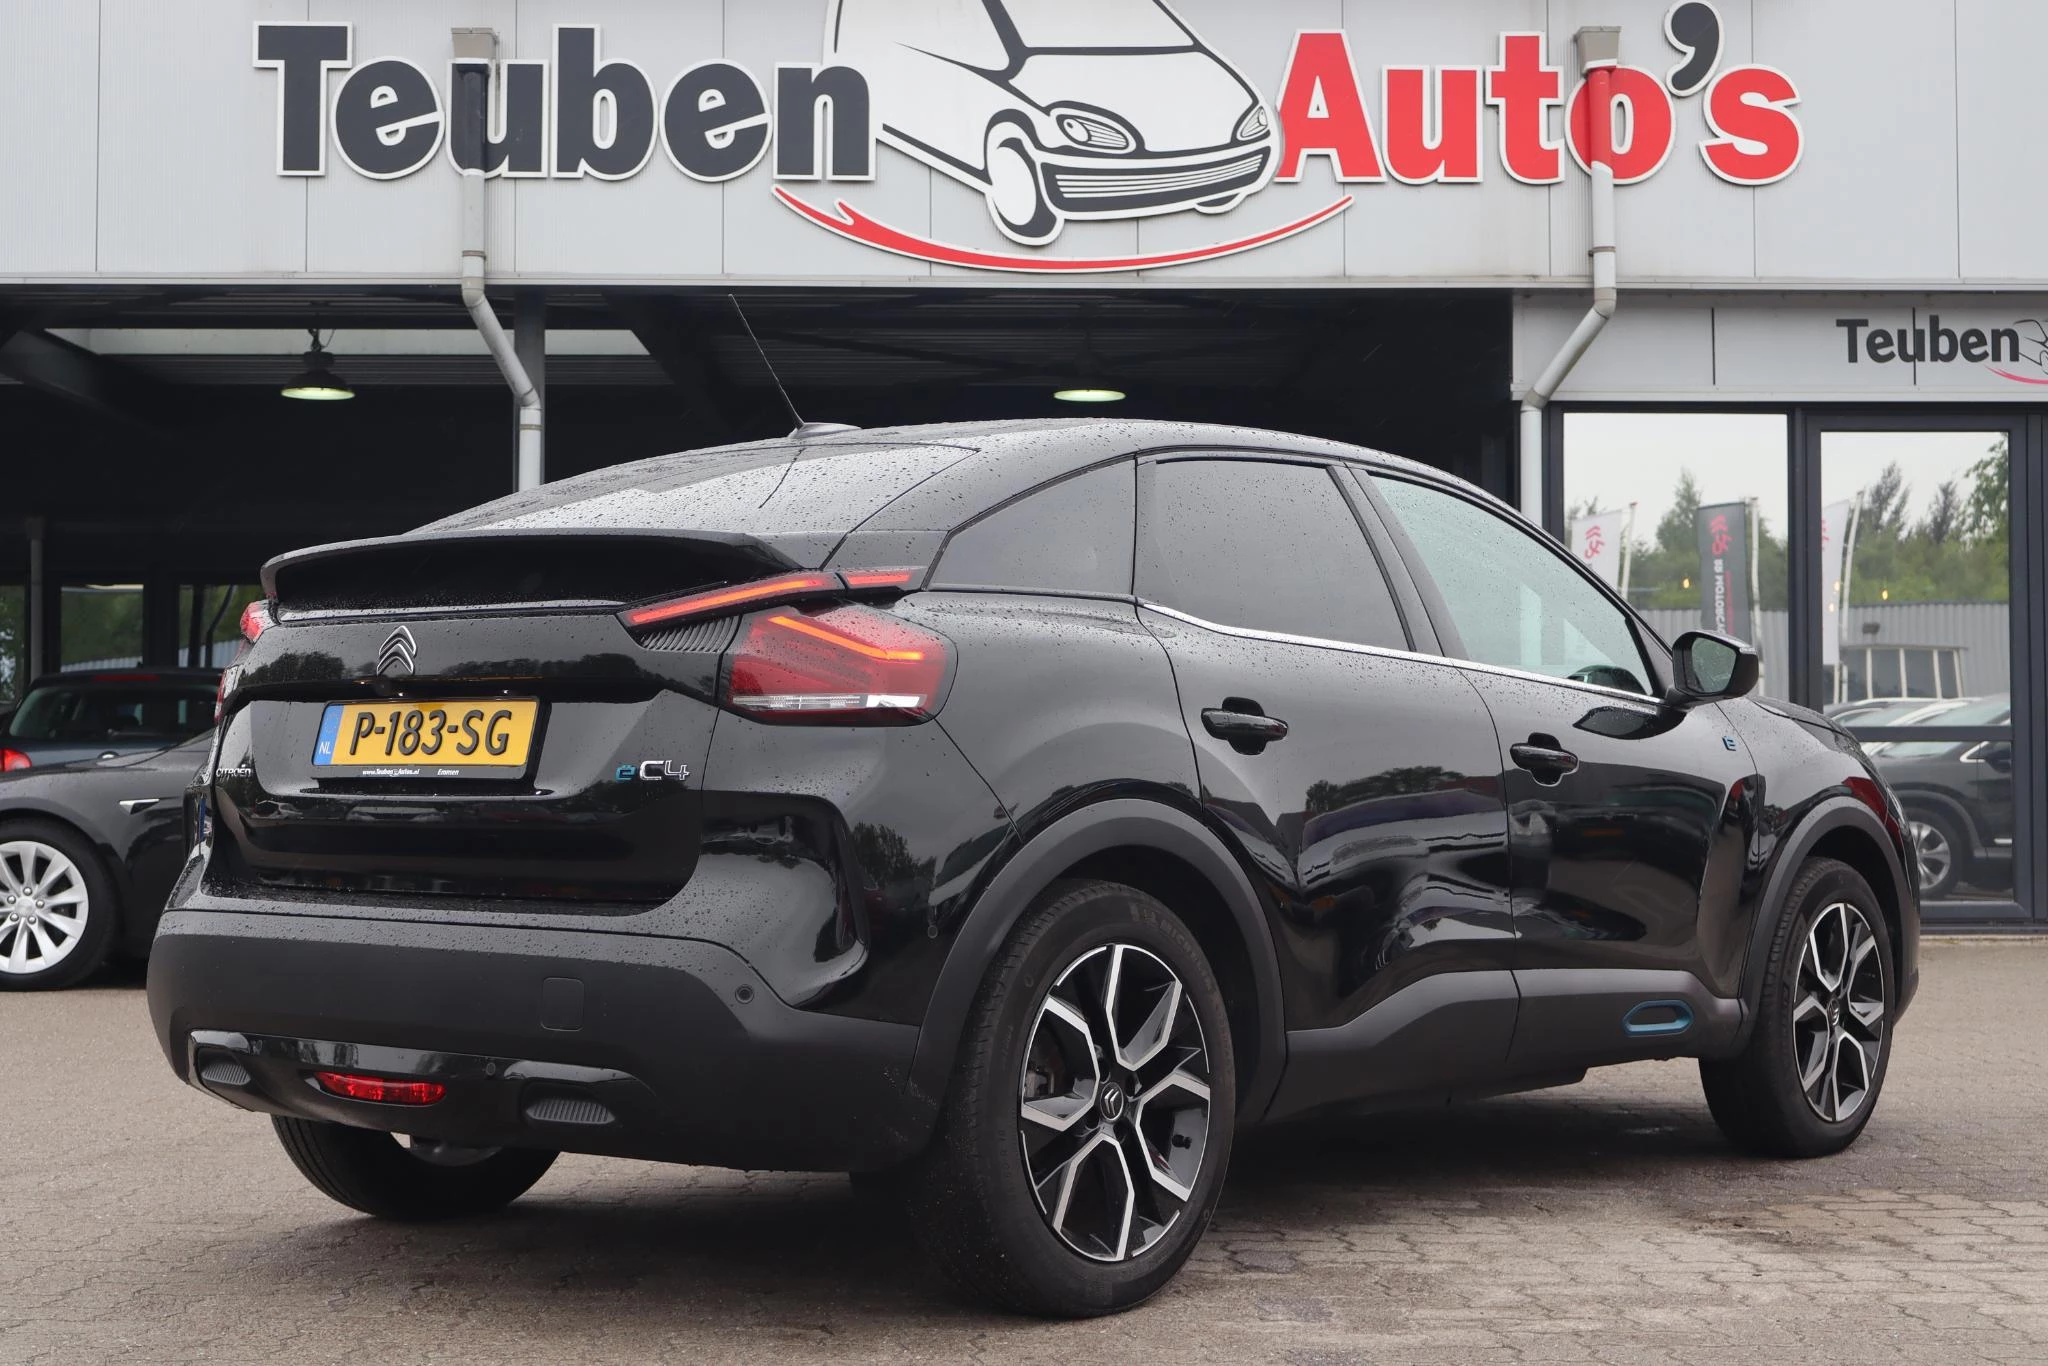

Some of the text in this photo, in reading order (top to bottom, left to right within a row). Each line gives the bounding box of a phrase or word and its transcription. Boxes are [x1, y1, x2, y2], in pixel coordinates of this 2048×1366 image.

[254, 0, 1804, 186] Teuben Auto's
[1836, 314, 2020, 364] Teuben
[318, 741, 331, 755] NL
[349, 709, 512, 756] P-183-SG
